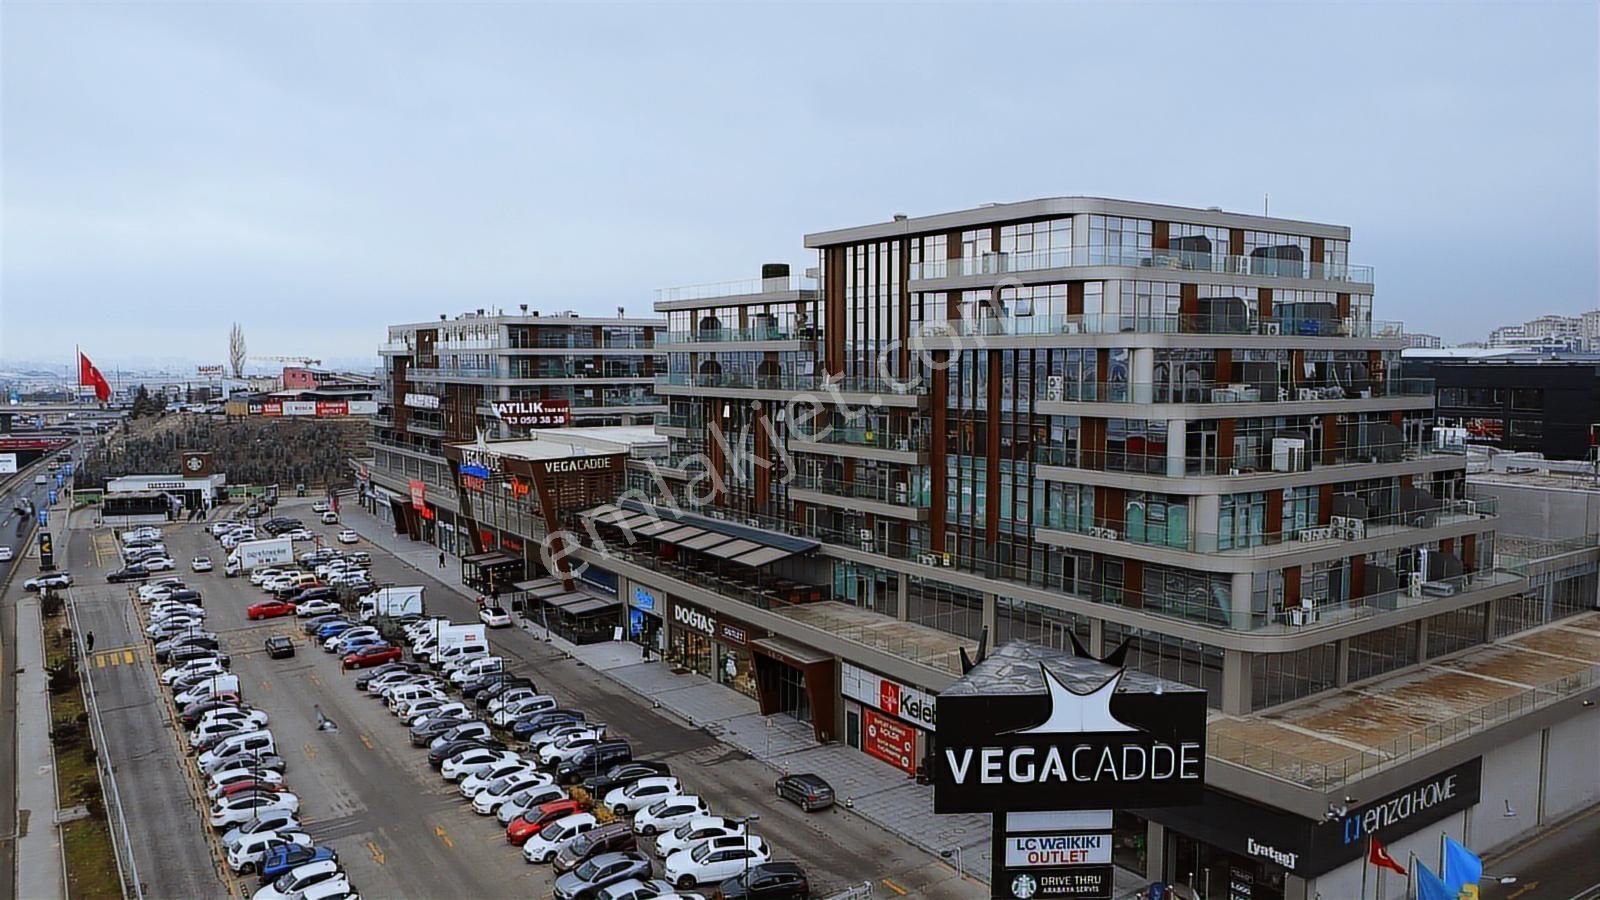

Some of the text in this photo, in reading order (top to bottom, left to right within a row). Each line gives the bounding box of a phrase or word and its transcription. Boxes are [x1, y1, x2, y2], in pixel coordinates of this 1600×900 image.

[544, 457, 612, 473] VEGACADDE
[945, 743, 1200, 784] VEGACADDE
[1016, 838, 1038, 851] LC
[1027, 849, 1089, 864] OUTLET
[1041, 875, 1102, 886] DRIVE THRU
